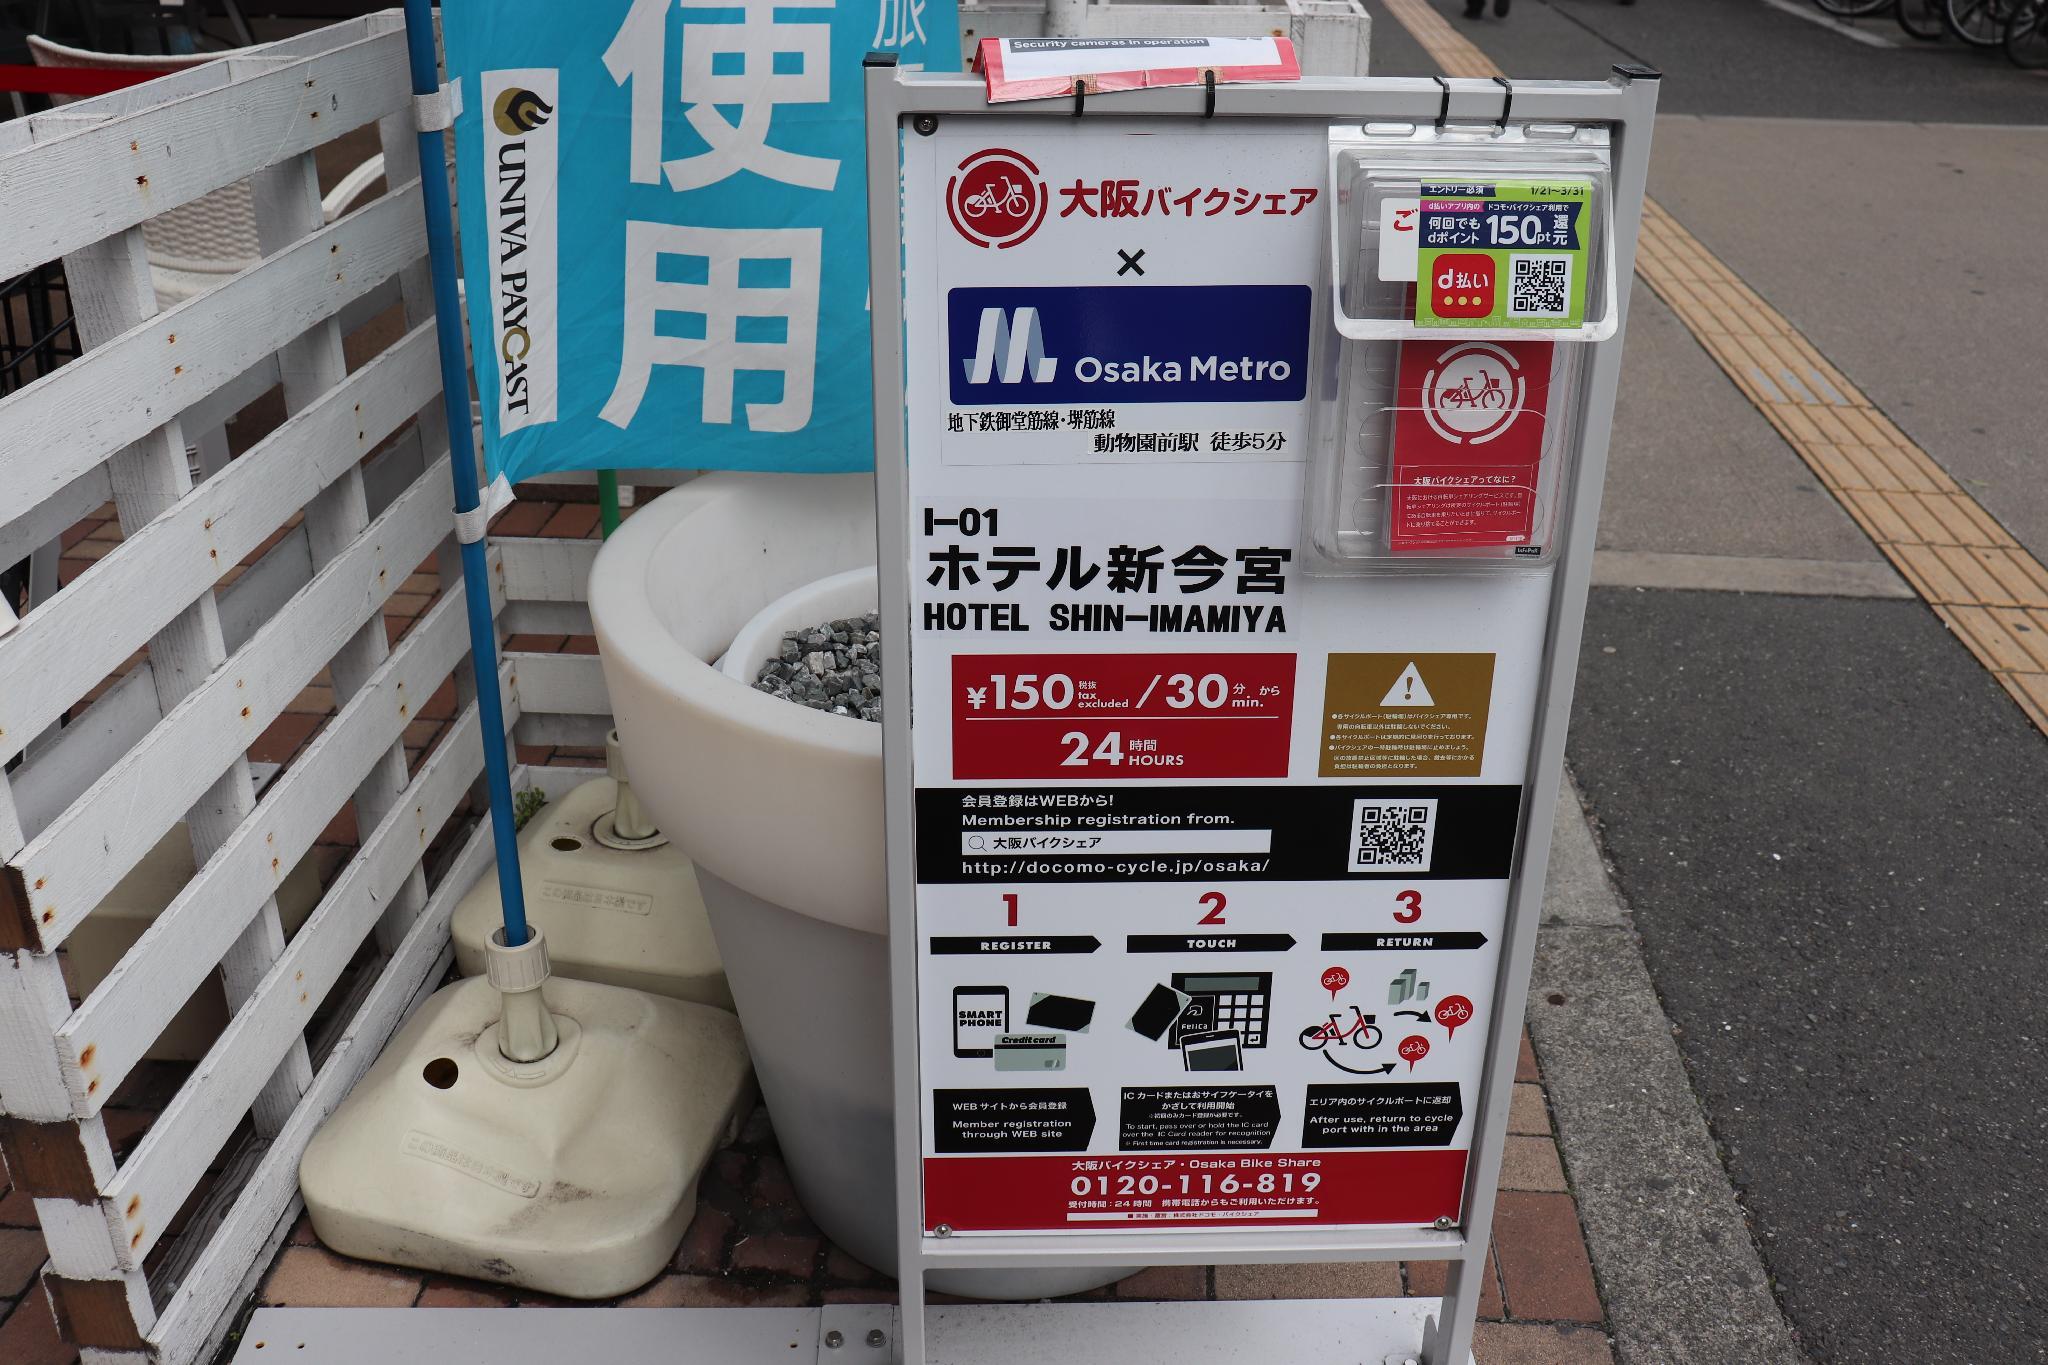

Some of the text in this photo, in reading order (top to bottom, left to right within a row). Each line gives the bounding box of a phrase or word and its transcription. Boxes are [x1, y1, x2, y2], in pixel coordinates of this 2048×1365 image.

[1014, 37, 1205, 49] Security cameras in operation
[1429, 185, 1484, 195] エントリー必須
[1059, 178, 1319, 218] 大阪バイクシェア
[1428, 202, 1480, 211] d払いアプリ内の
[1429, 217, 1480, 230] 何回でも
[1428, 231, 1480, 245] dポイント
[499, 140, 531, 416] UNIVA PAYCAST
[1438, 268, 1489, 289] d払い
[1074, 355, 1292, 383] Osaka Metro
[1094, 432, 1287, 453] 動物園前駅 徒歩5分
[926, 544, 1292, 595] ホテル新今宮
[923, 603, 1030, 632] HOTEL
[967, 673, 1075, 710] ¥150
[1079, 680, 1097, 690] 税抜
[1232, 683, 1280, 697] 分 から
[1078, 691, 1097, 700] tax
[1232, 695, 1264, 708] min.
[1078, 699, 1129, 709] excluded
[1060, 731, 1125, 766] 24
[1129, 739, 1157, 752] 時間
[1128, 754, 1184, 766] HOURS
[962, 813, 1235, 827] Membership registration from.
[993, 836, 1102, 849] 大阪バイクシェア
[962, 859, 1270, 876] http://docomo-cycle.jp/osaka/
[1002, 893, 1018, 926] 1
[1197, 891, 1227, 925] 2
[1393, 890, 1422, 924] 3
[981, 941, 1051, 951] REGISTER
[1187, 939, 1237, 949] TOUCH
[1376, 937, 1434, 948] RETURN
[958, 1010, 1003, 1019] SMART
[959, 1019, 1002, 1027] PHONE
[1001, 1035, 1056, 1044] Credit card
[1162, 1102, 1235, 1110] かざして利用開始
[1003, 1120, 1072, 1129] registration
[1310, 1116, 1339, 1124] After
[1370, 1115, 1406, 1123] return
[1424, 1114, 1454, 1124] cycle
[962, 1130, 1063, 1139] through WEB site
[1228, 1129, 1271, 1137] recognition
[1322, 1126, 1347, 1135] port
[1351, 1125, 1374, 1133] with
[1378, 1125, 1388, 1133] in
[1392, 1125, 1410, 1133] the
[1240, 1158, 1273, 1168] Bike
[1278, 1158, 1321, 1167] Share
[1071, 1172, 1321, 1196] 0120-116-819
